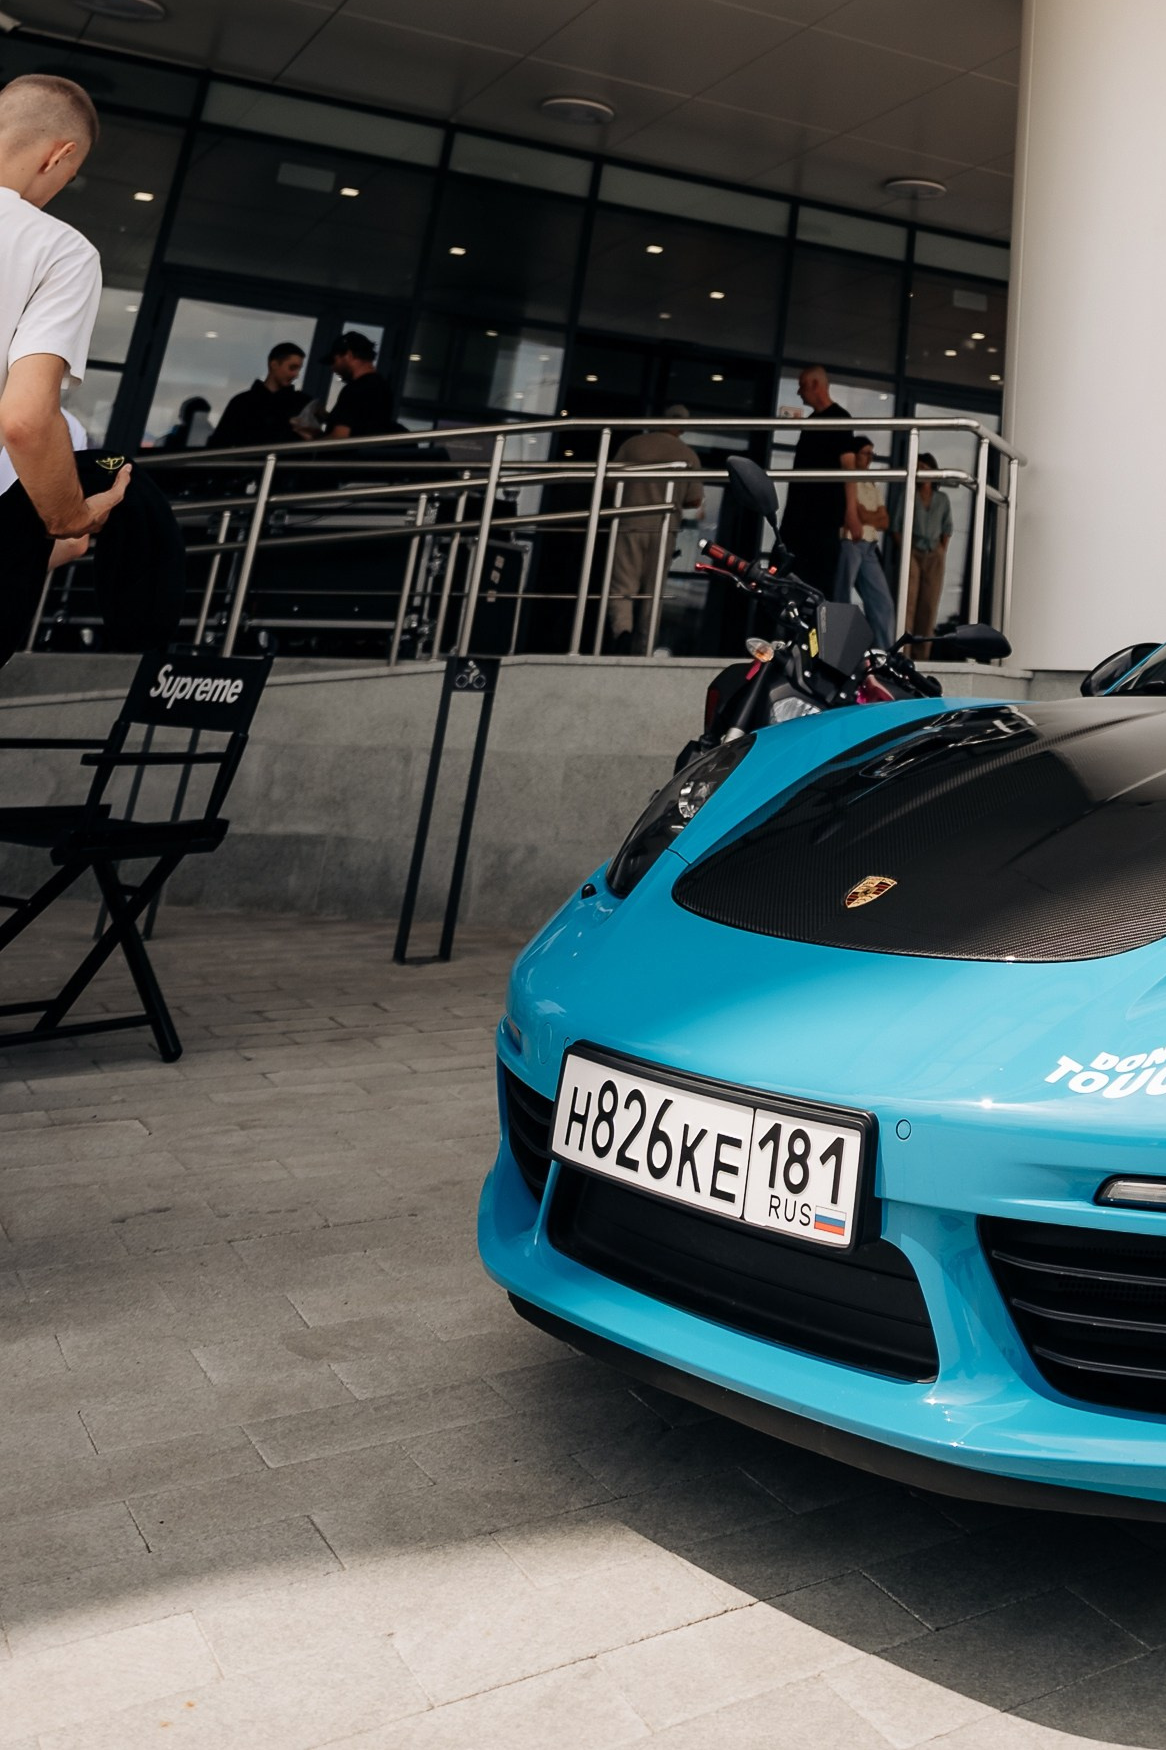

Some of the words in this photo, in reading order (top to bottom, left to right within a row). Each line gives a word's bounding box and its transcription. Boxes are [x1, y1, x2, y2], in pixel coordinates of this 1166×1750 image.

[149, 663, 244, 710] Supreme
[758, 1122, 845, 1204] 181
[768, 1194, 812, 1227] RUS
